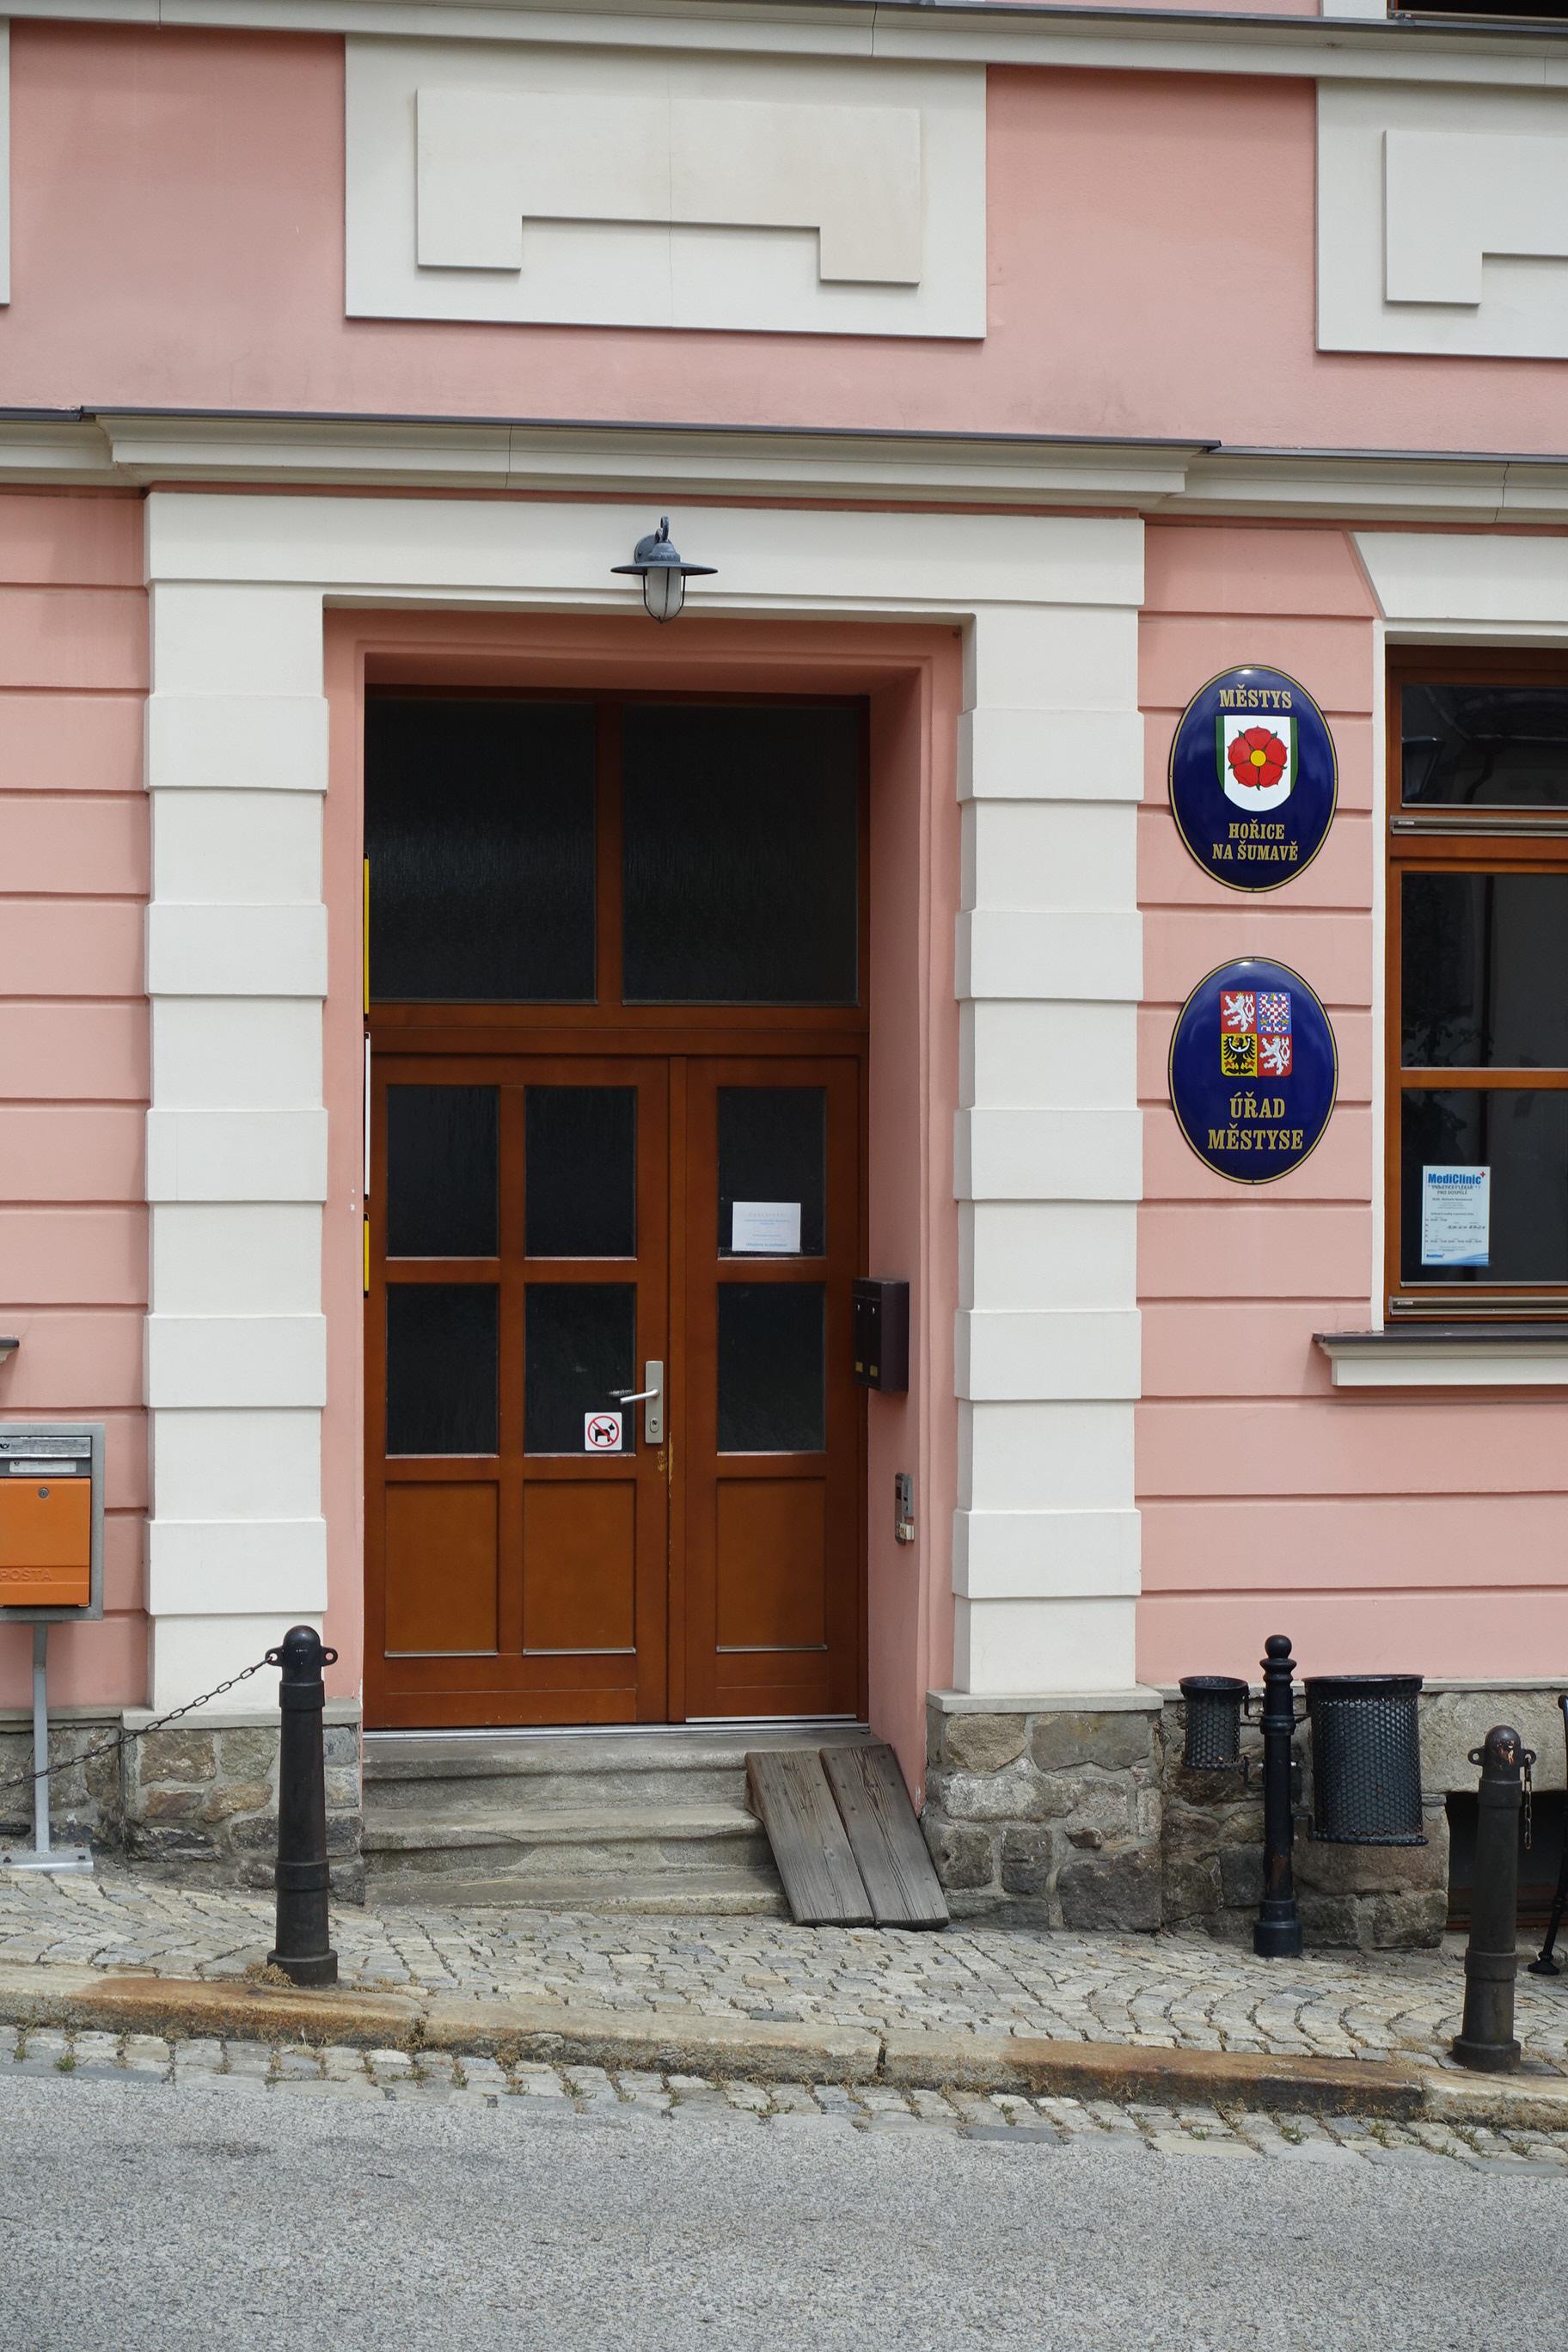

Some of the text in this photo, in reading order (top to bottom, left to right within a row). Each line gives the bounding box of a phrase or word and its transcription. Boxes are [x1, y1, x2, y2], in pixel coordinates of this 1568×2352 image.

[1219, 683, 1293, 709] MĚSTYS
[1228, 819, 1285, 840] HOŘICE
[1212, 840, 1298, 861] NA ŠUMAVĚ
[1229, 1091, 1285, 1118] ÚŘAD
[1208, 1123, 1303, 1150] MĚSTYSE
[1428, 1173, 1481, 1184] MediClinic
